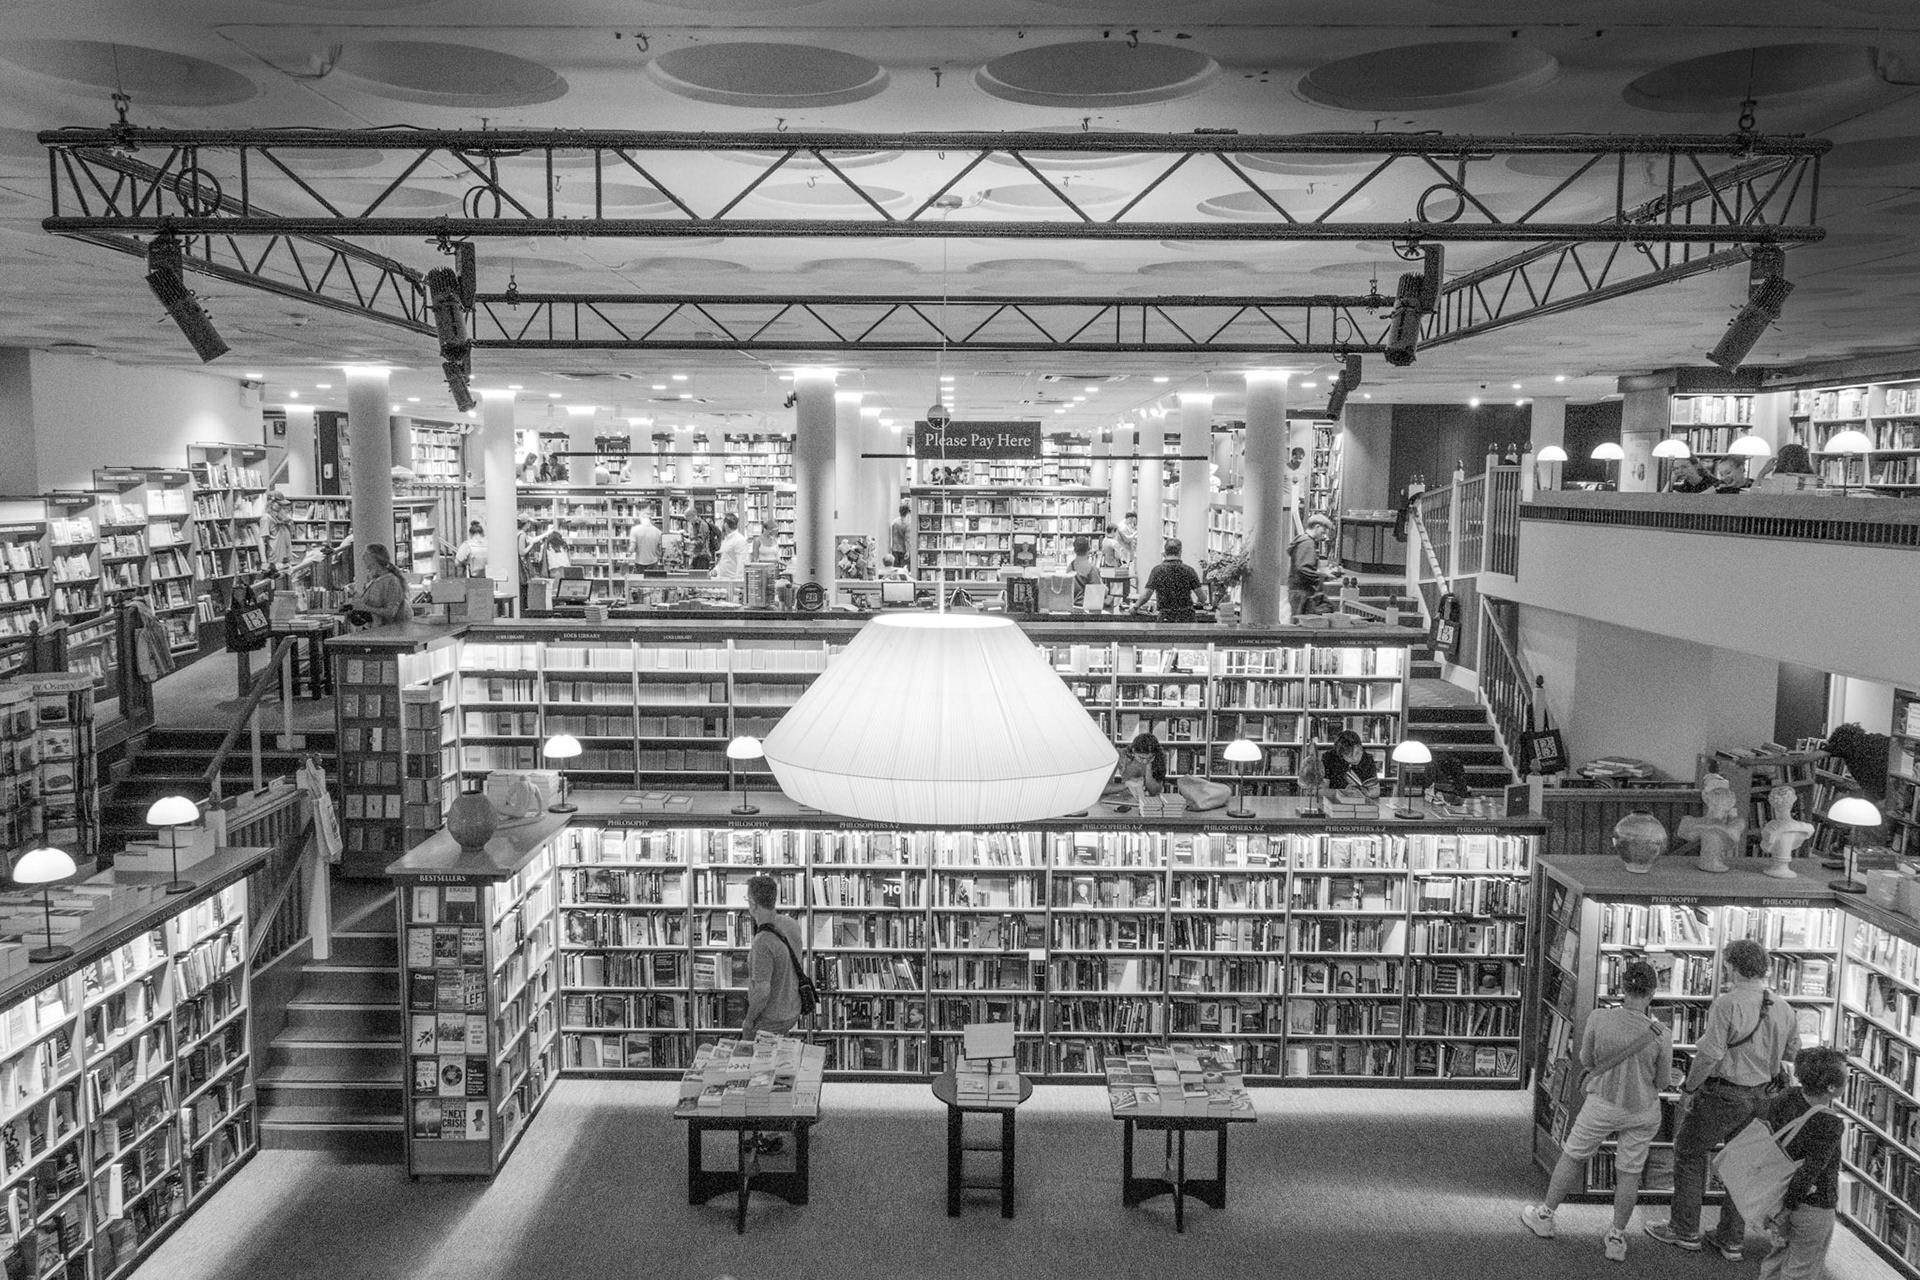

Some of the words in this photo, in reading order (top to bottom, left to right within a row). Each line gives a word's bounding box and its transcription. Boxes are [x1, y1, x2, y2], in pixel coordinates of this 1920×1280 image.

[925, 433, 967, 447] Please
[971, 433, 994, 450] Pay
[998, 433, 1031, 447] Here
[806, 593, 817, 601] 28
[420, 874, 466, 882] BESTSELLERS
[1762, 898, 1810, 906] PHILOSOPHY
[435, 949, 458, 958] IDEAS
[464, 990, 486, 1006] LEFT
[448, 1109, 467, 1119] NEXT
[442, 1118, 467, 1128] CRISIS
